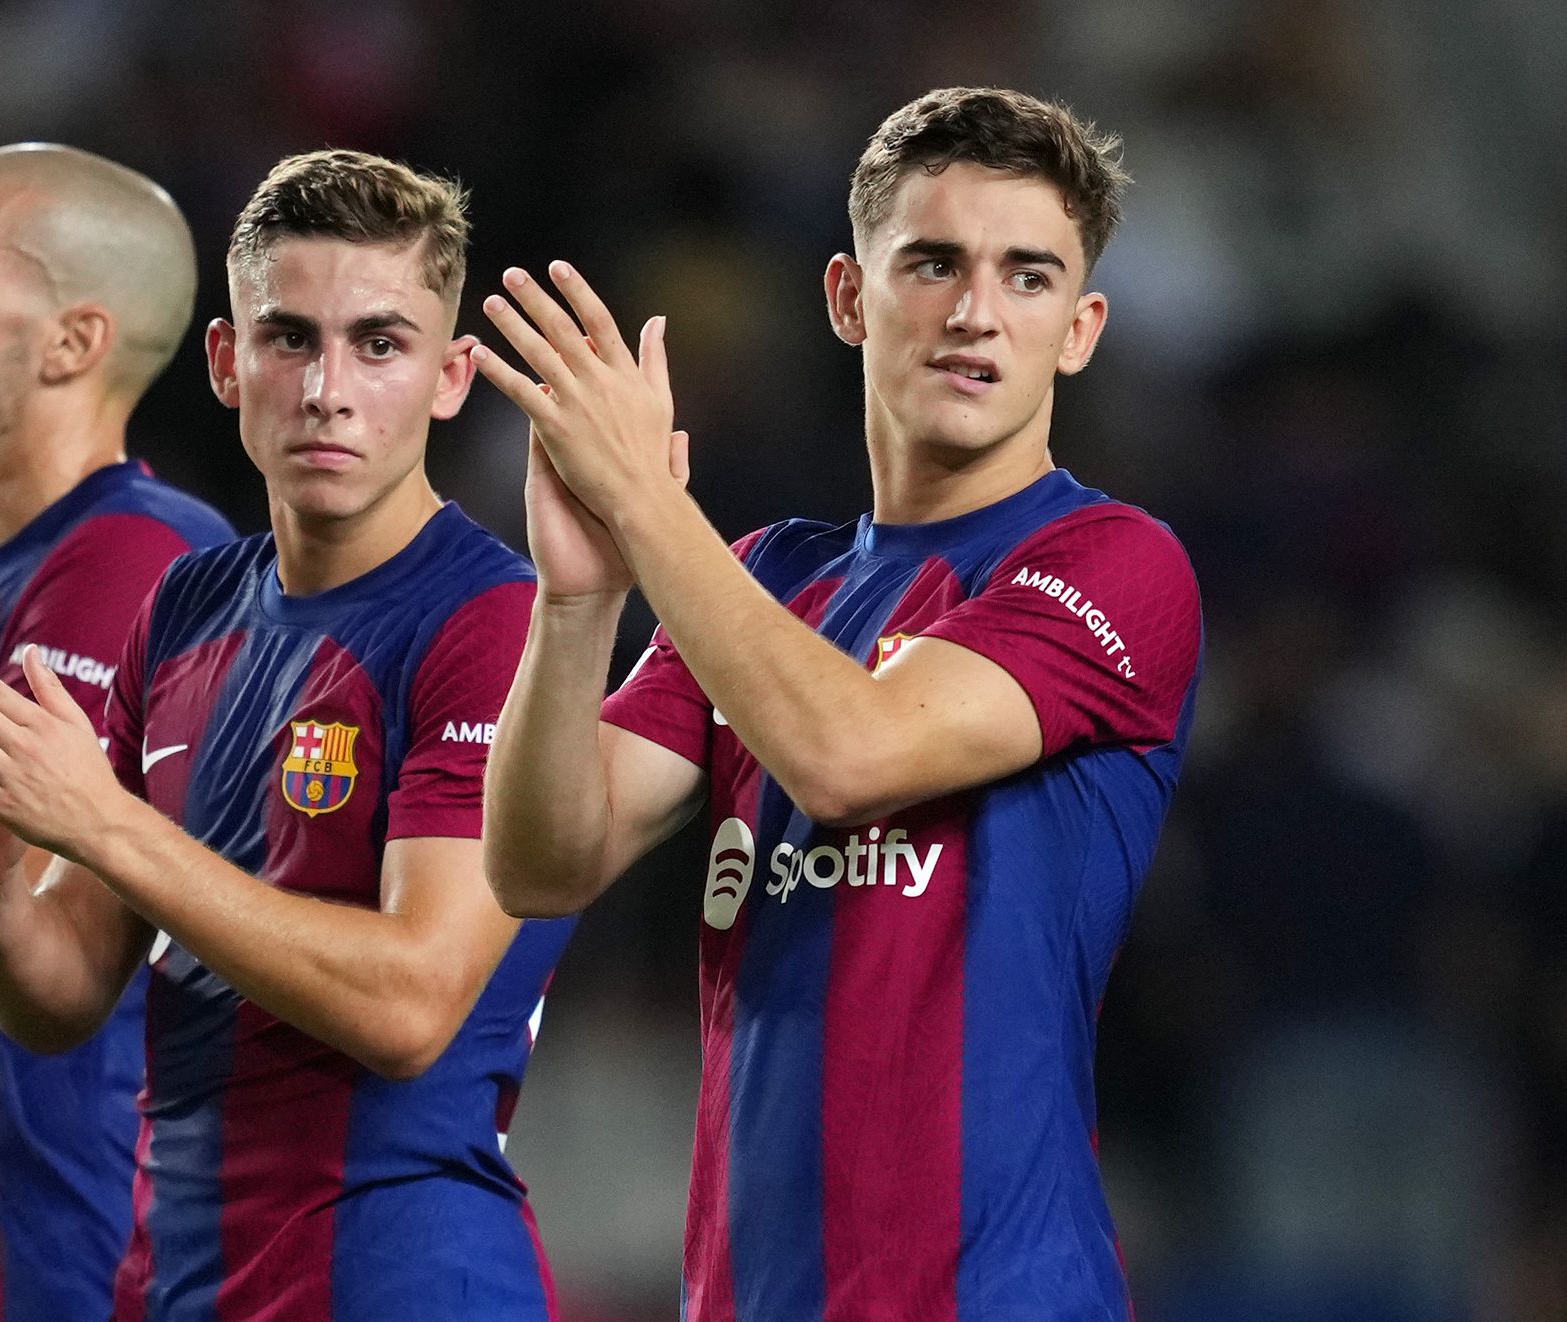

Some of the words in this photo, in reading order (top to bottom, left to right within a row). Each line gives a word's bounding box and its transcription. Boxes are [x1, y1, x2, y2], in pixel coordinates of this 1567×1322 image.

[1011, 567, 1126, 656] AMBILIGHT
[1117, 656, 1136, 679] tv
[304, 760, 332, 773] FCB
[765, 826, 944, 904] Spotify
